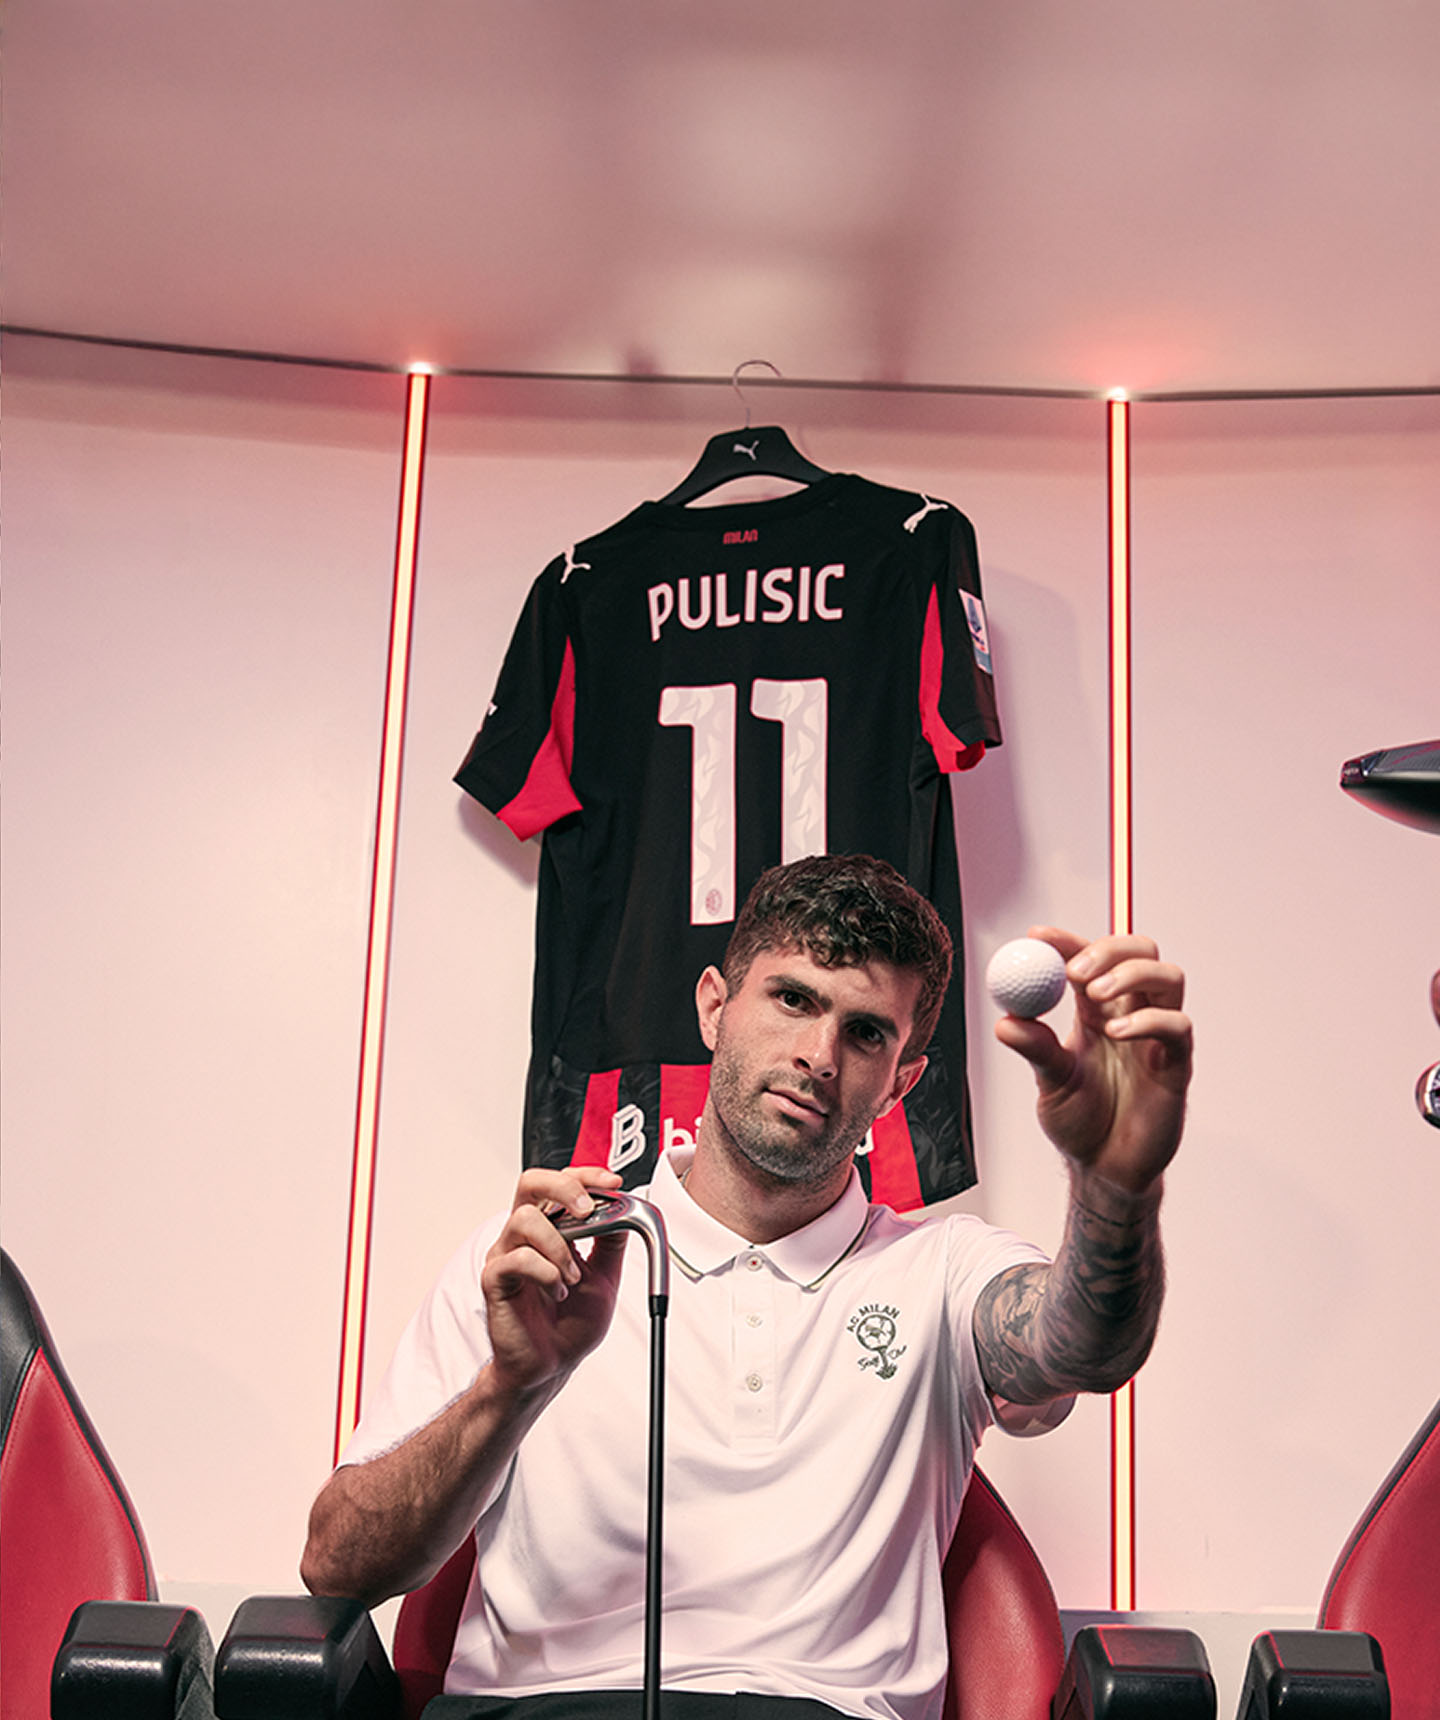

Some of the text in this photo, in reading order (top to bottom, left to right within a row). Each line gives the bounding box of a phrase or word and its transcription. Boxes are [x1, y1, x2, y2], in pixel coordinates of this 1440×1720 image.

[647, 563, 845, 642] PULISIC
[658, 677, 828, 925] 11
[846, 1304, 900, 1332] AC MILAN
